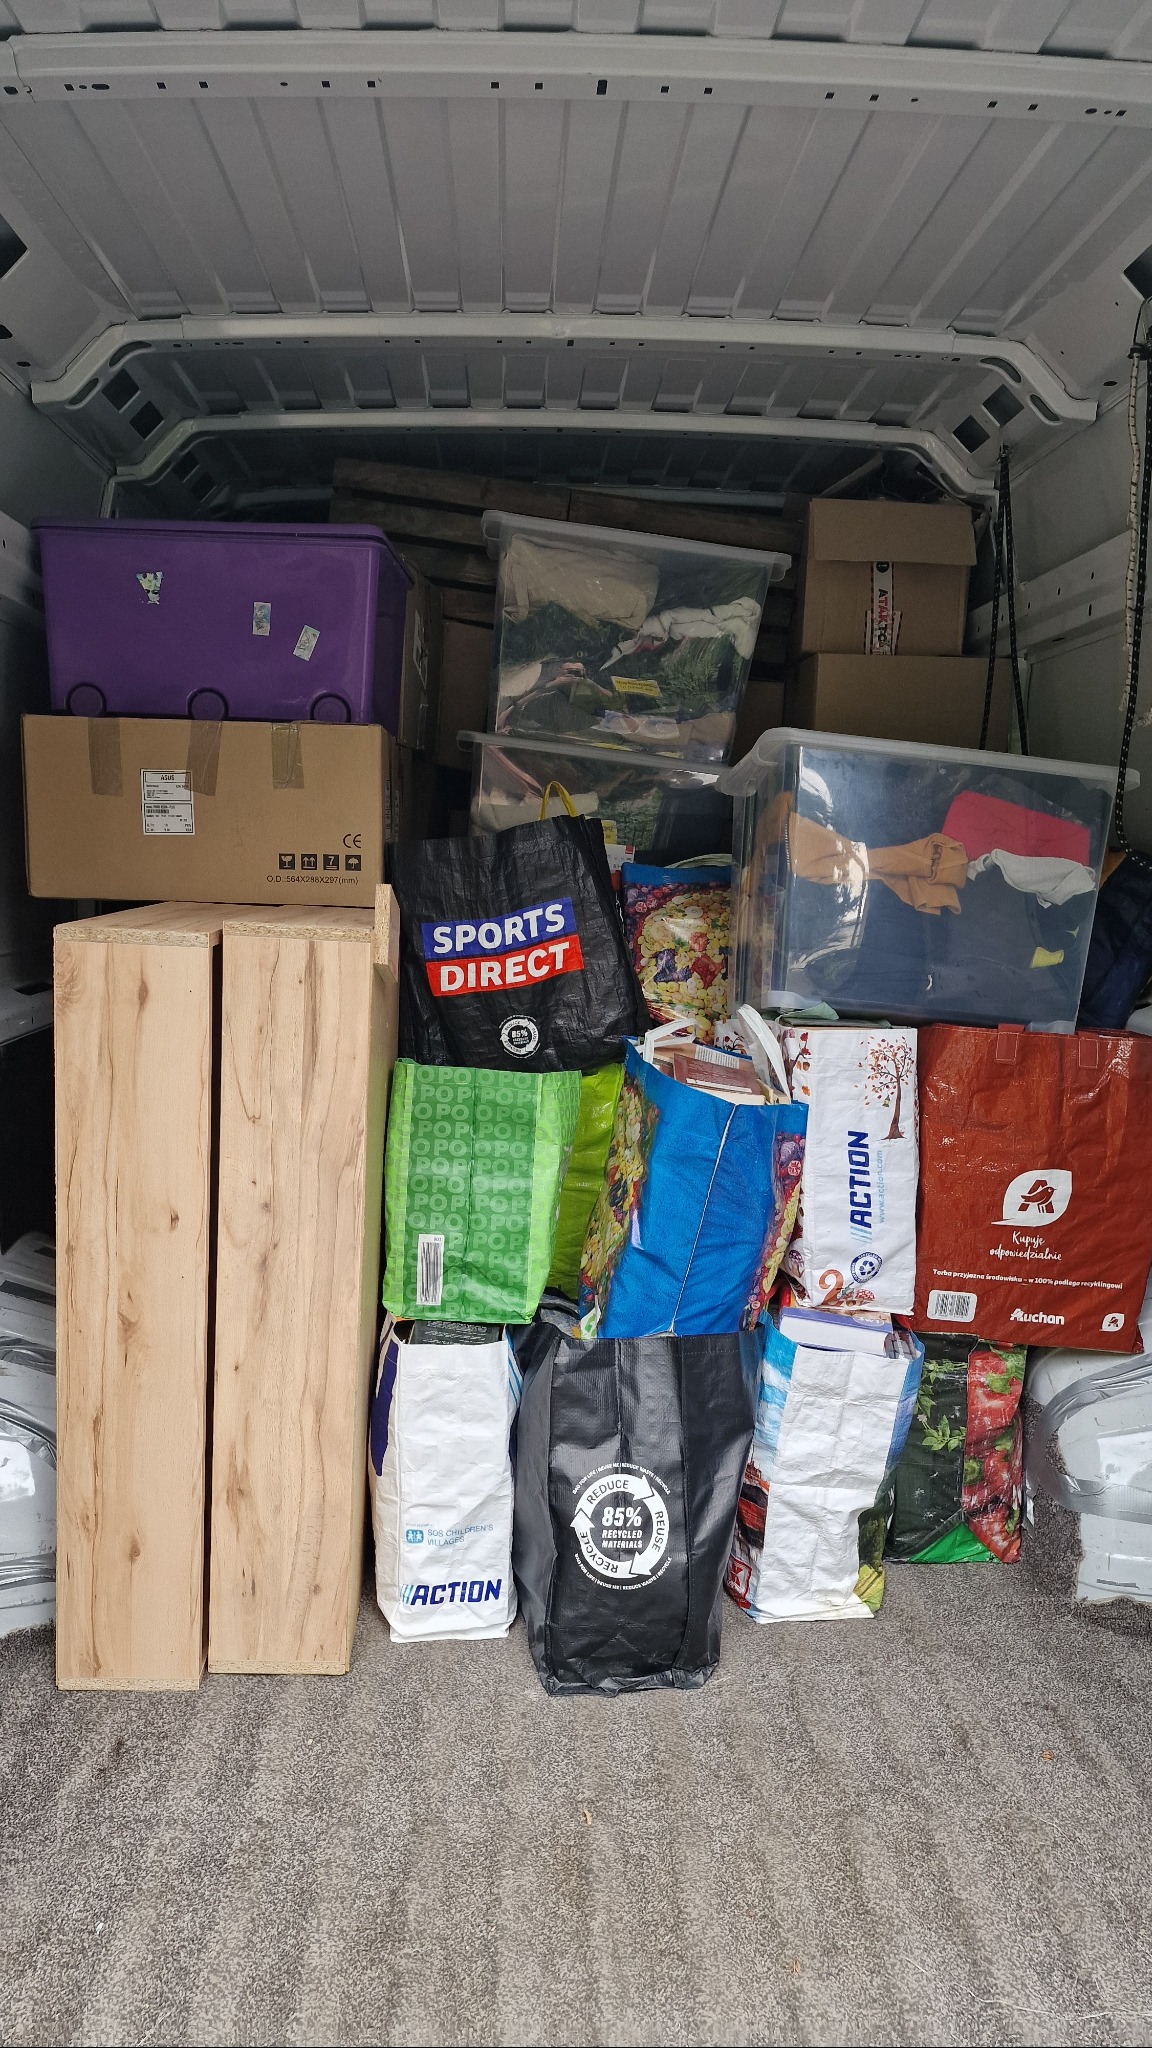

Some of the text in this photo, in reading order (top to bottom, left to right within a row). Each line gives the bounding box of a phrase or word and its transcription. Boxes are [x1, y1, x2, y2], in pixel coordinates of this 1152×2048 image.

[433, 903, 565, 954] SPORTS
[440, 941, 570, 992] DIRECT
[511, 1029, 529, 1038] 85%
[847, 1130, 873, 1229] ACTION
[876, 1149, 885, 1224] www.action.com
[1012, 1230, 1045, 1249] Kupuję
[989, 1243, 1062, 1261] odpowiedzialnie
[932, 1268, 952, 1277] Torba
[953, 1271, 985, 1280] przyjazna
[985, 1273, 1022, 1283] środowisku
[1034, 1277, 1053, 1285] 100%
[1054, 1278, 1080, 1288] podlega
[1081, 1280, 1123, 1290] recyklingowi
[1009, 1307, 1066, 1326] Auchan
[586, 1479, 629, 1505] REDUCE
[601, 1506, 642, 1527] 85%
[427, 1528, 444, 1537] SOS
[445, 1523, 494, 1537] CHILDREN'S
[601, 1529, 643, 1539] RECYCLED
[651, 1510, 666, 1552] REUSE
[427, 1535, 465, 1547] VILLAGES
[601, 1540, 643, 1549] MATERIALS
[579, 1531, 619, 1574] RECYCLE
[410, 1578, 502, 1606] ACTION
